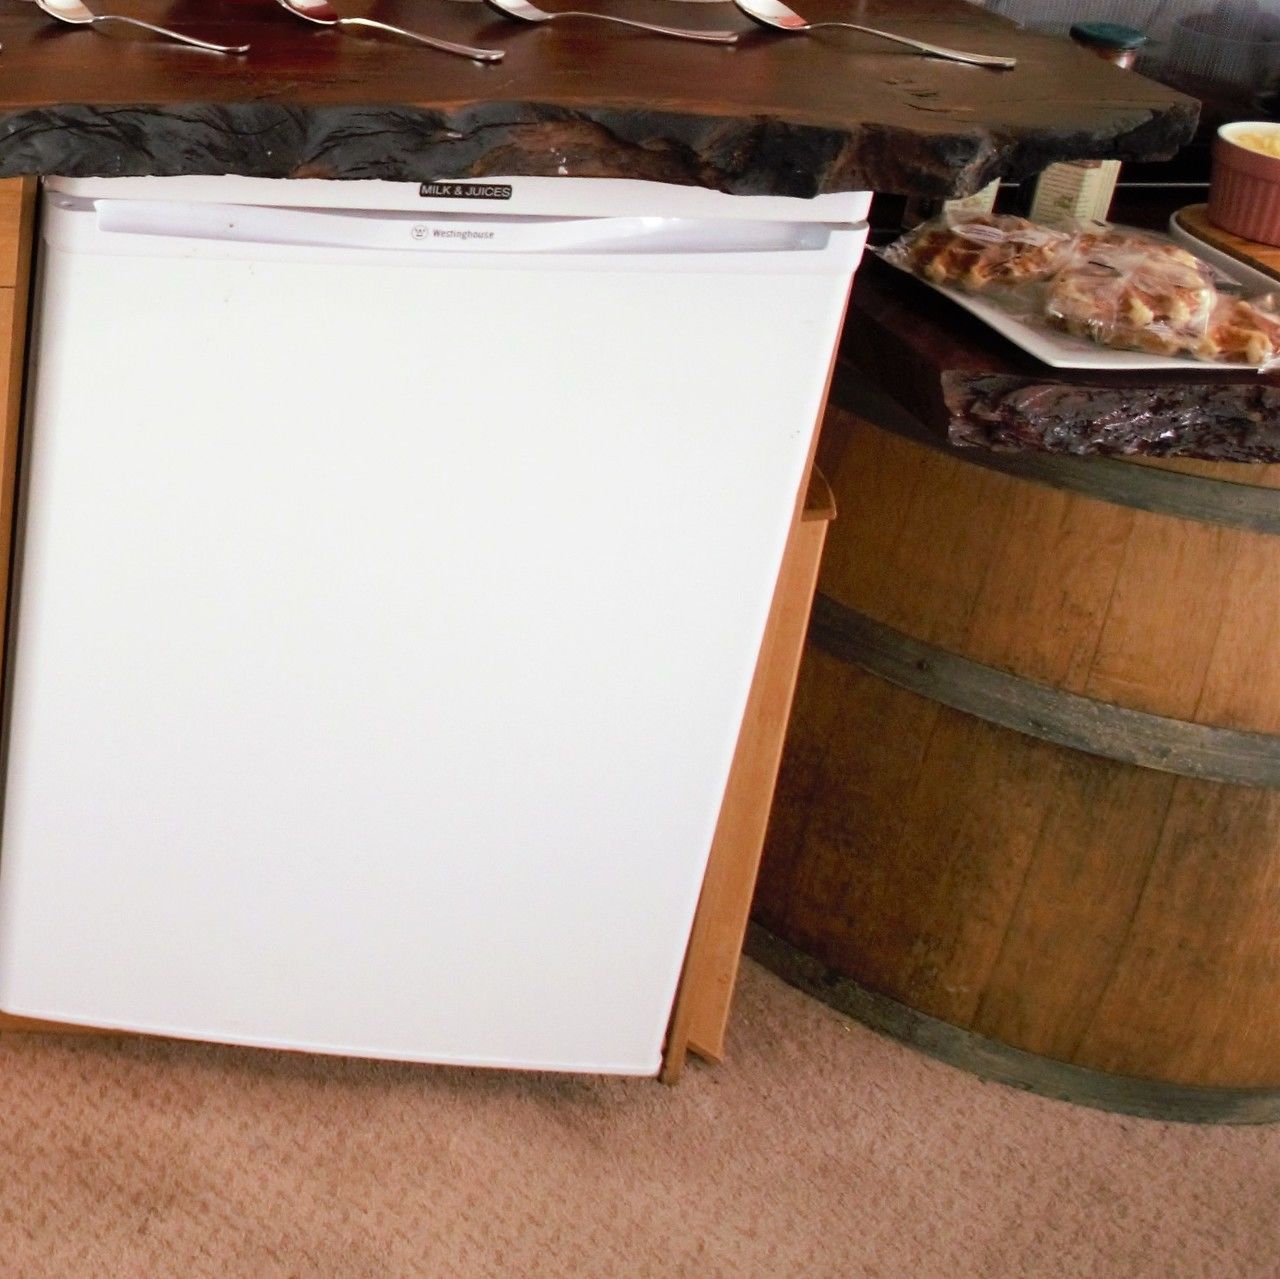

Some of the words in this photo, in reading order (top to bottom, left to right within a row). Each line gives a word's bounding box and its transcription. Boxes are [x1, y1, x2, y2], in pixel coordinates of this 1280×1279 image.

[421, 184, 452, 196] MILK
[454, 185, 463, 196] &
[465, 186, 512, 198] JUICES
[432, 228, 496, 240] Westinghouse
